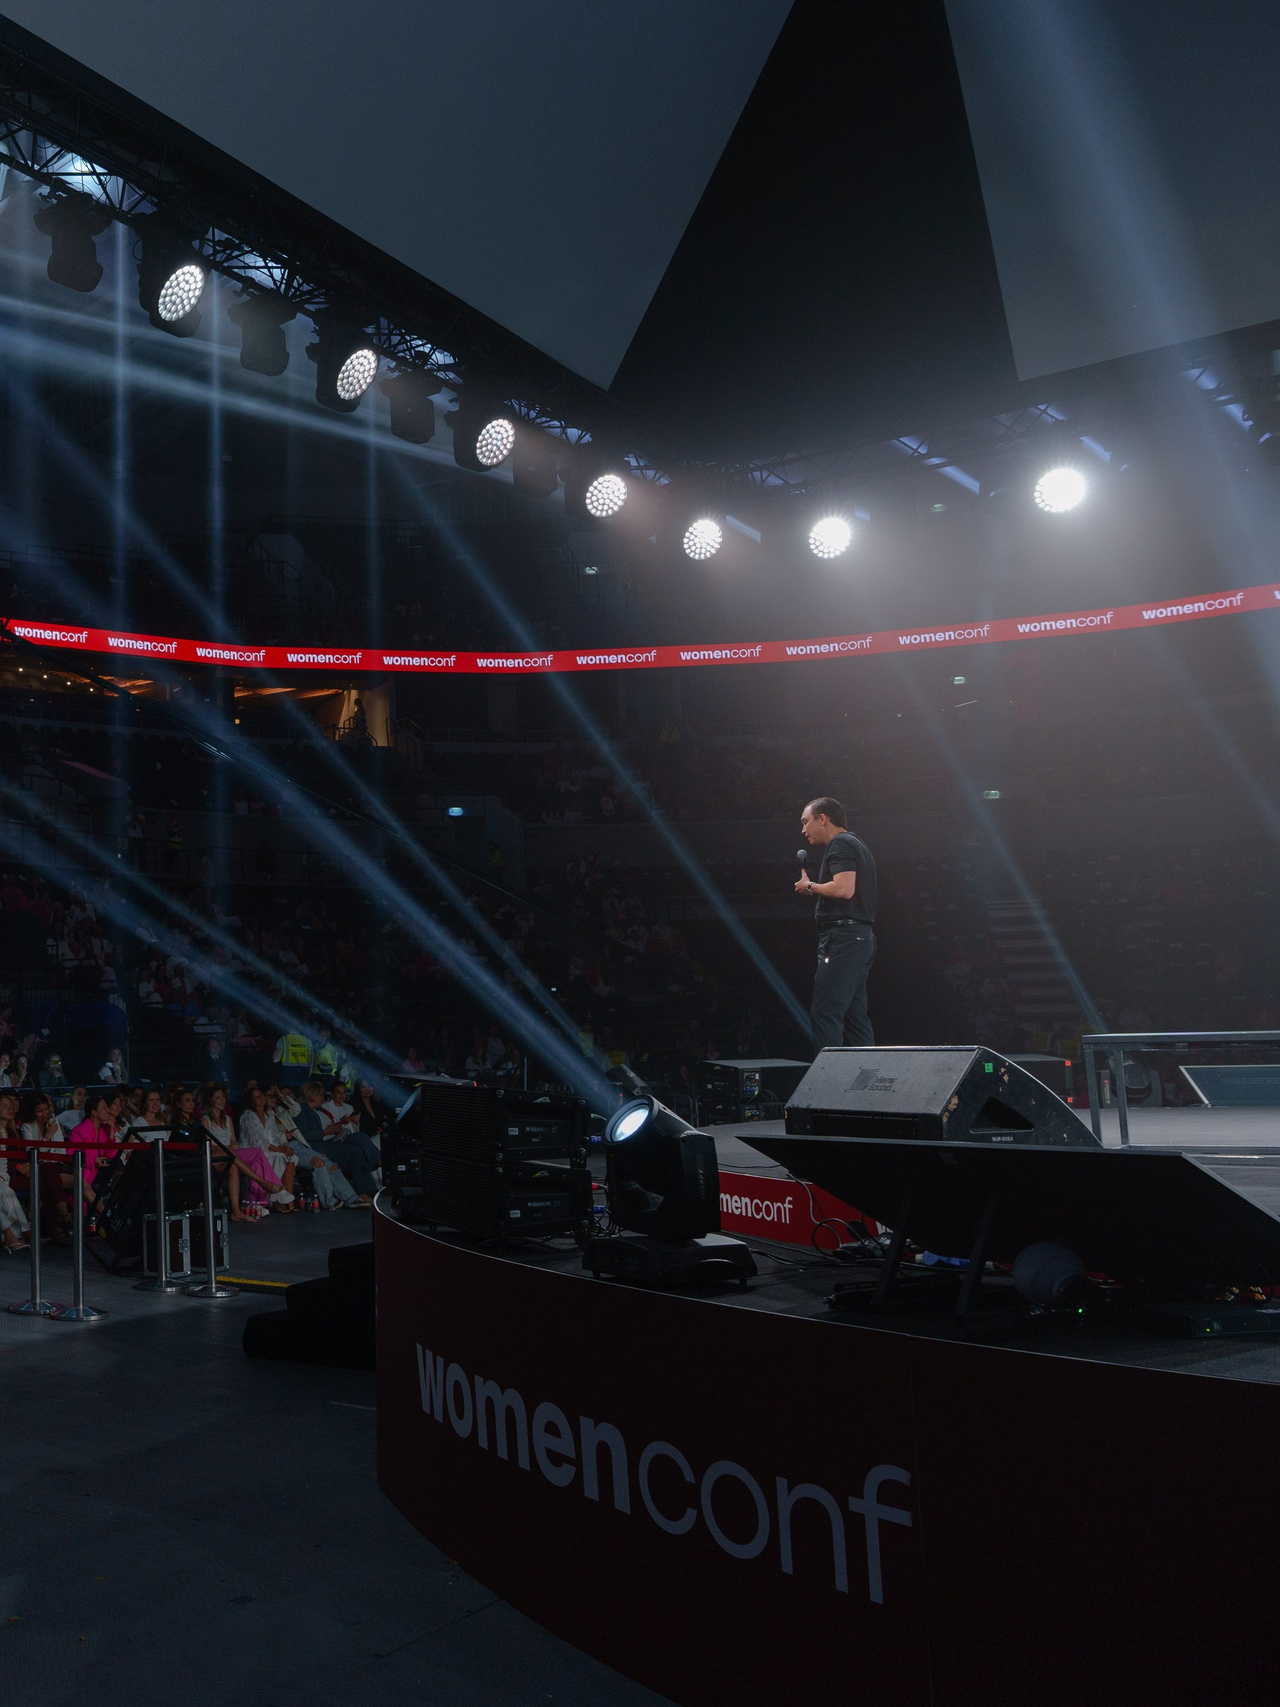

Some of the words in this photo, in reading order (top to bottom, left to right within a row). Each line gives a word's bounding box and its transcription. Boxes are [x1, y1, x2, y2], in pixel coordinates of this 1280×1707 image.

[1141, 592, 1244, 620] womenconf
[1016, 611, 1114, 633] womenconf
[13, 626, 89, 644] womenconf
[898, 624, 991, 645] womenconf
[107, 636, 178, 654] womenconf
[679, 645, 762, 661] womenconf
[785, 635, 873, 656] womenconf
[195, 647, 266, 662] womenconf
[286, 651, 363, 665] womenconf
[382, 654, 457, 667] womenconf
[476, 653, 554, 668] womenconf
[575, 649, 657, 665] womenconf
[719, 1192, 793, 1224] menconf
[416, 1342, 913, 1605] womenconf
